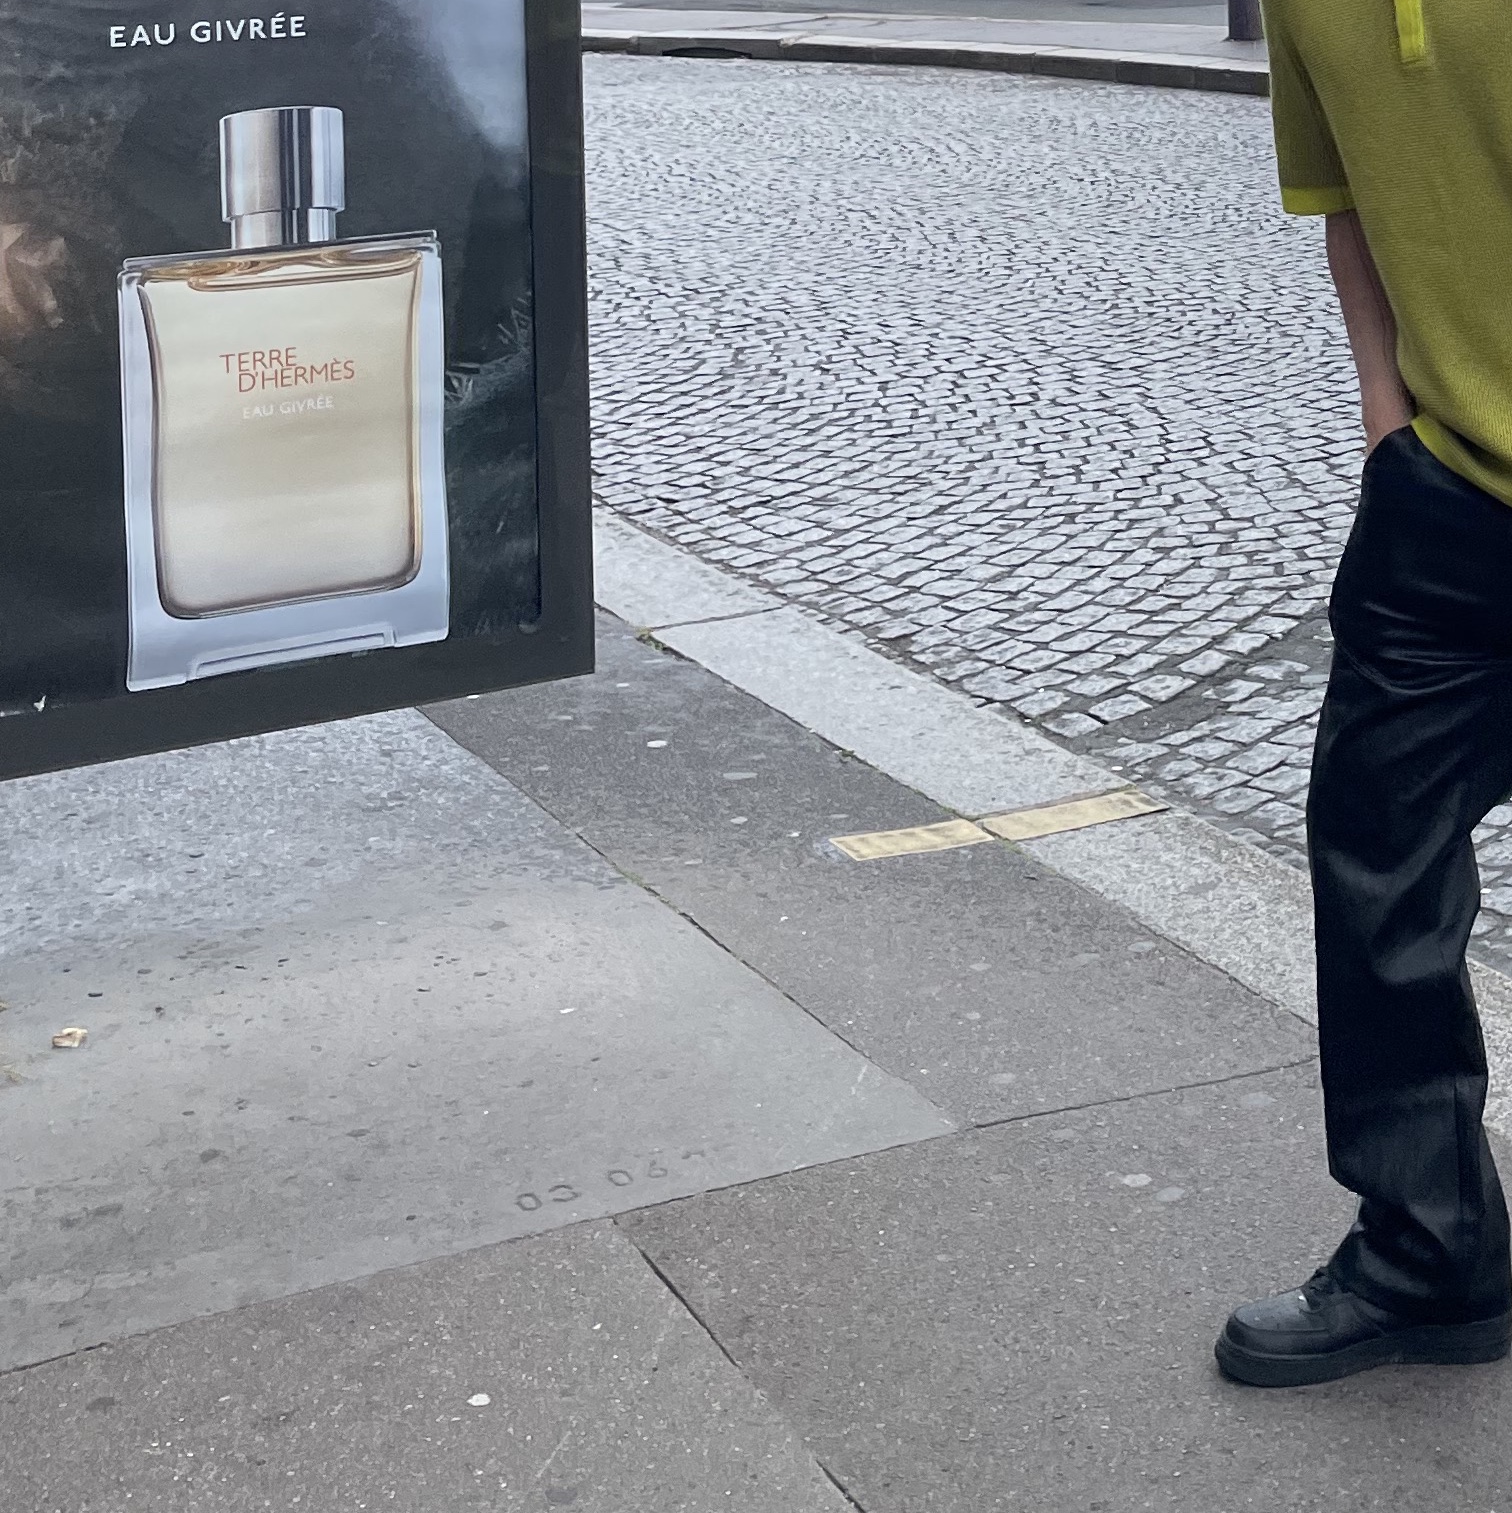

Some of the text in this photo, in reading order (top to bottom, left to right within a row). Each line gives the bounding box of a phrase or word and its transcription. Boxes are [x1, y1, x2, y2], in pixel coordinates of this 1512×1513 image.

[109, 12, 307, 48] EAU GIVRÉE
[219, 346, 298, 375] TERRE
[237, 358, 356, 393] D'HERMÈS
[242, 394, 335, 419] EAU GIVRÉE
